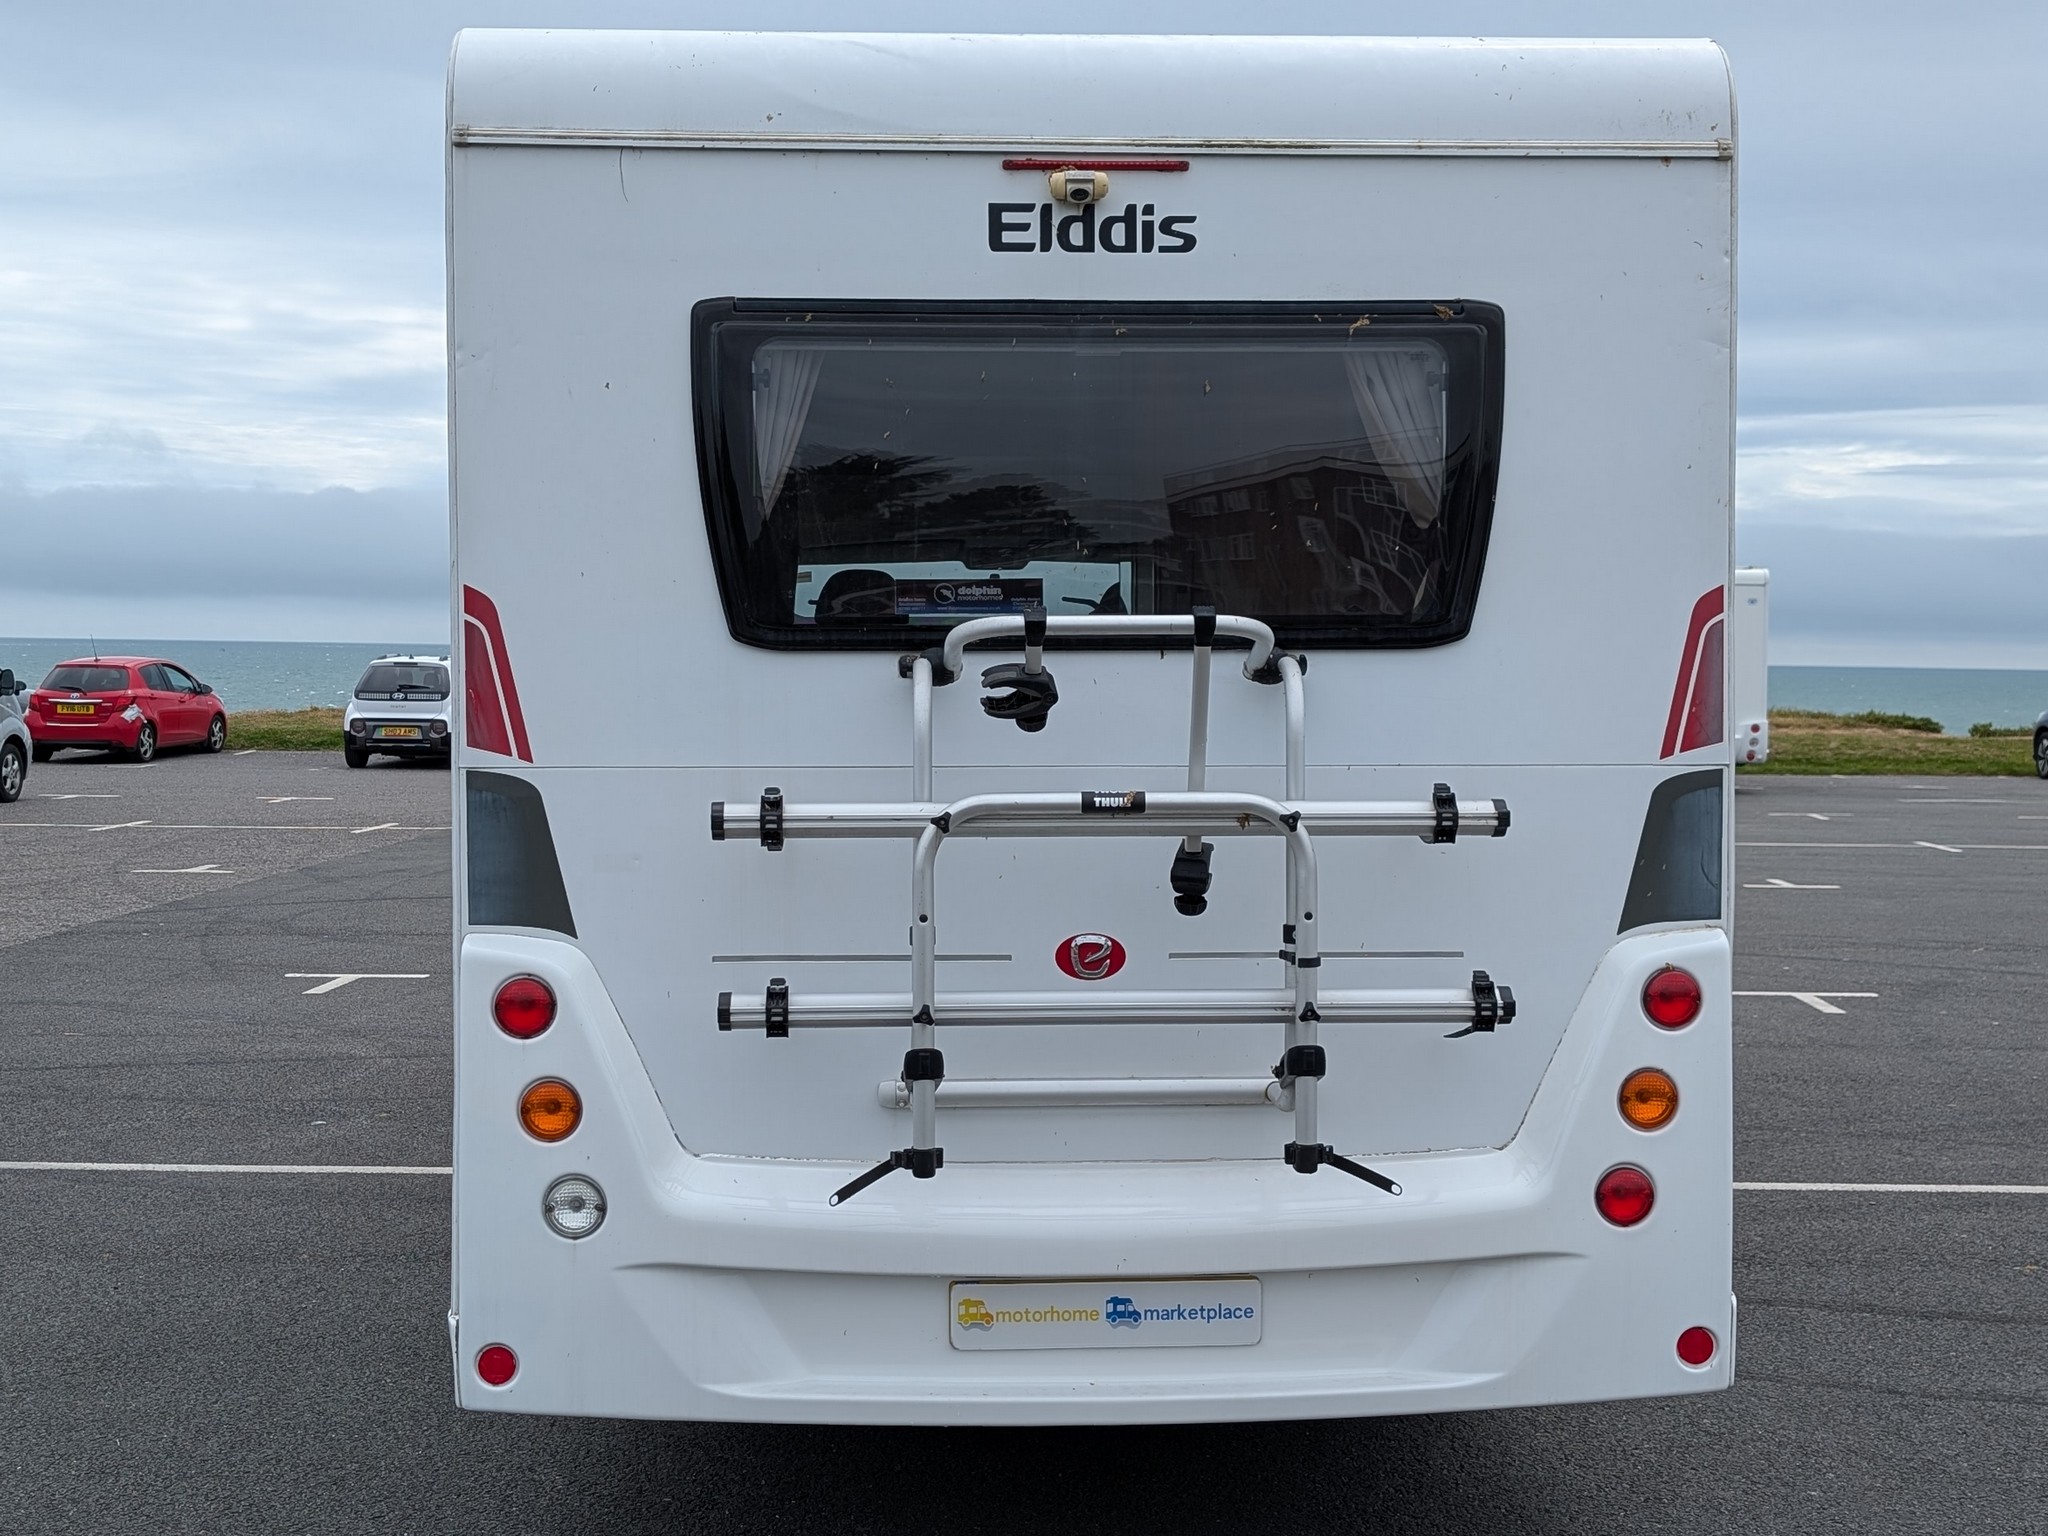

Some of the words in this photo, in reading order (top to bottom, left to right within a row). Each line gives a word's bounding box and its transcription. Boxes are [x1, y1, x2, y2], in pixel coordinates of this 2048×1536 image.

[988, 203, 1197, 253] Elddis
[957, 584, 1002, 596] dolphin
[995, 1305, 1100, 1323] motorhome
[1143, 1303, 1255, 1323] marketplace
